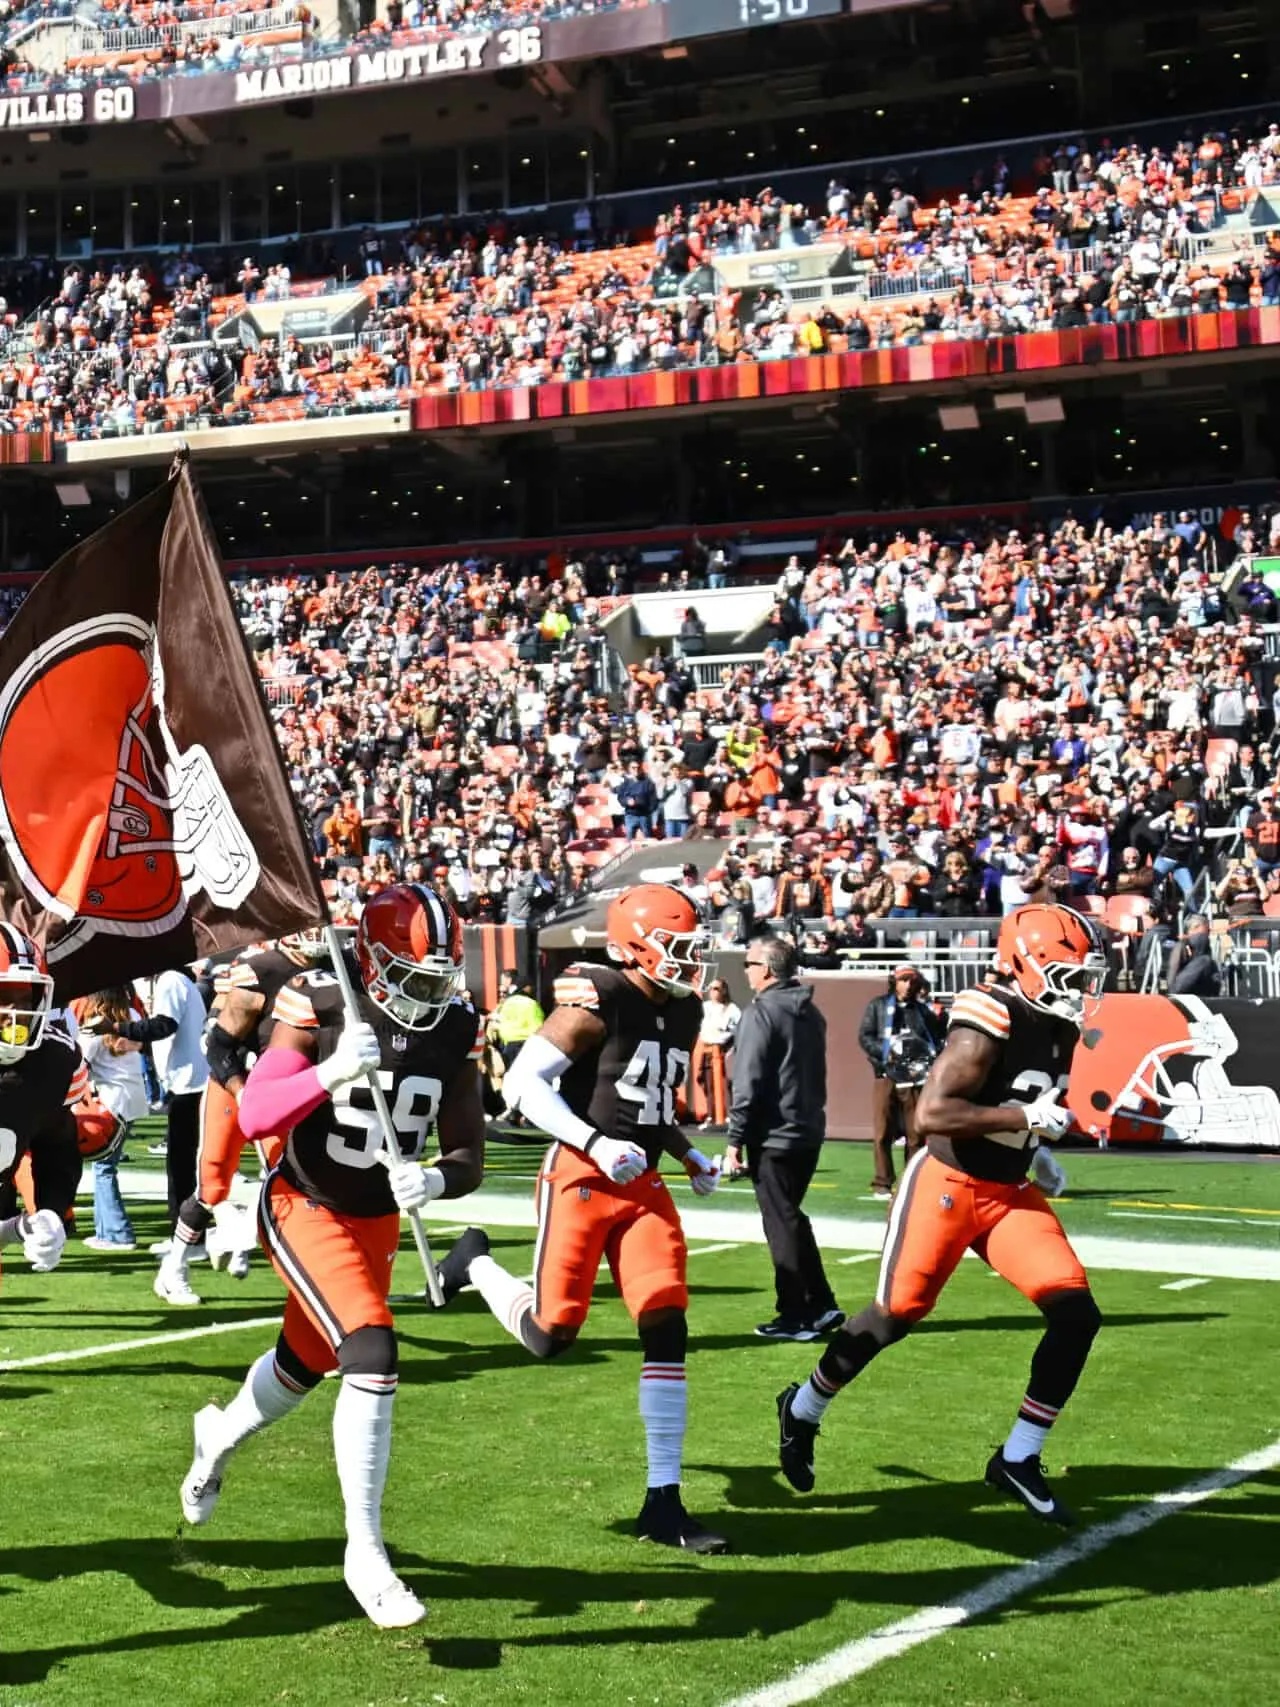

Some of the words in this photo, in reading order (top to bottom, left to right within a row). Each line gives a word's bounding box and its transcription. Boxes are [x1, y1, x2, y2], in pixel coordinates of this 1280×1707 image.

[236, 57, 352, 101] MARION
[359, 37, 487, 83] MOTLEY
[498, 27, 542, 64] 36
[93, 86, 134, 121] 60
